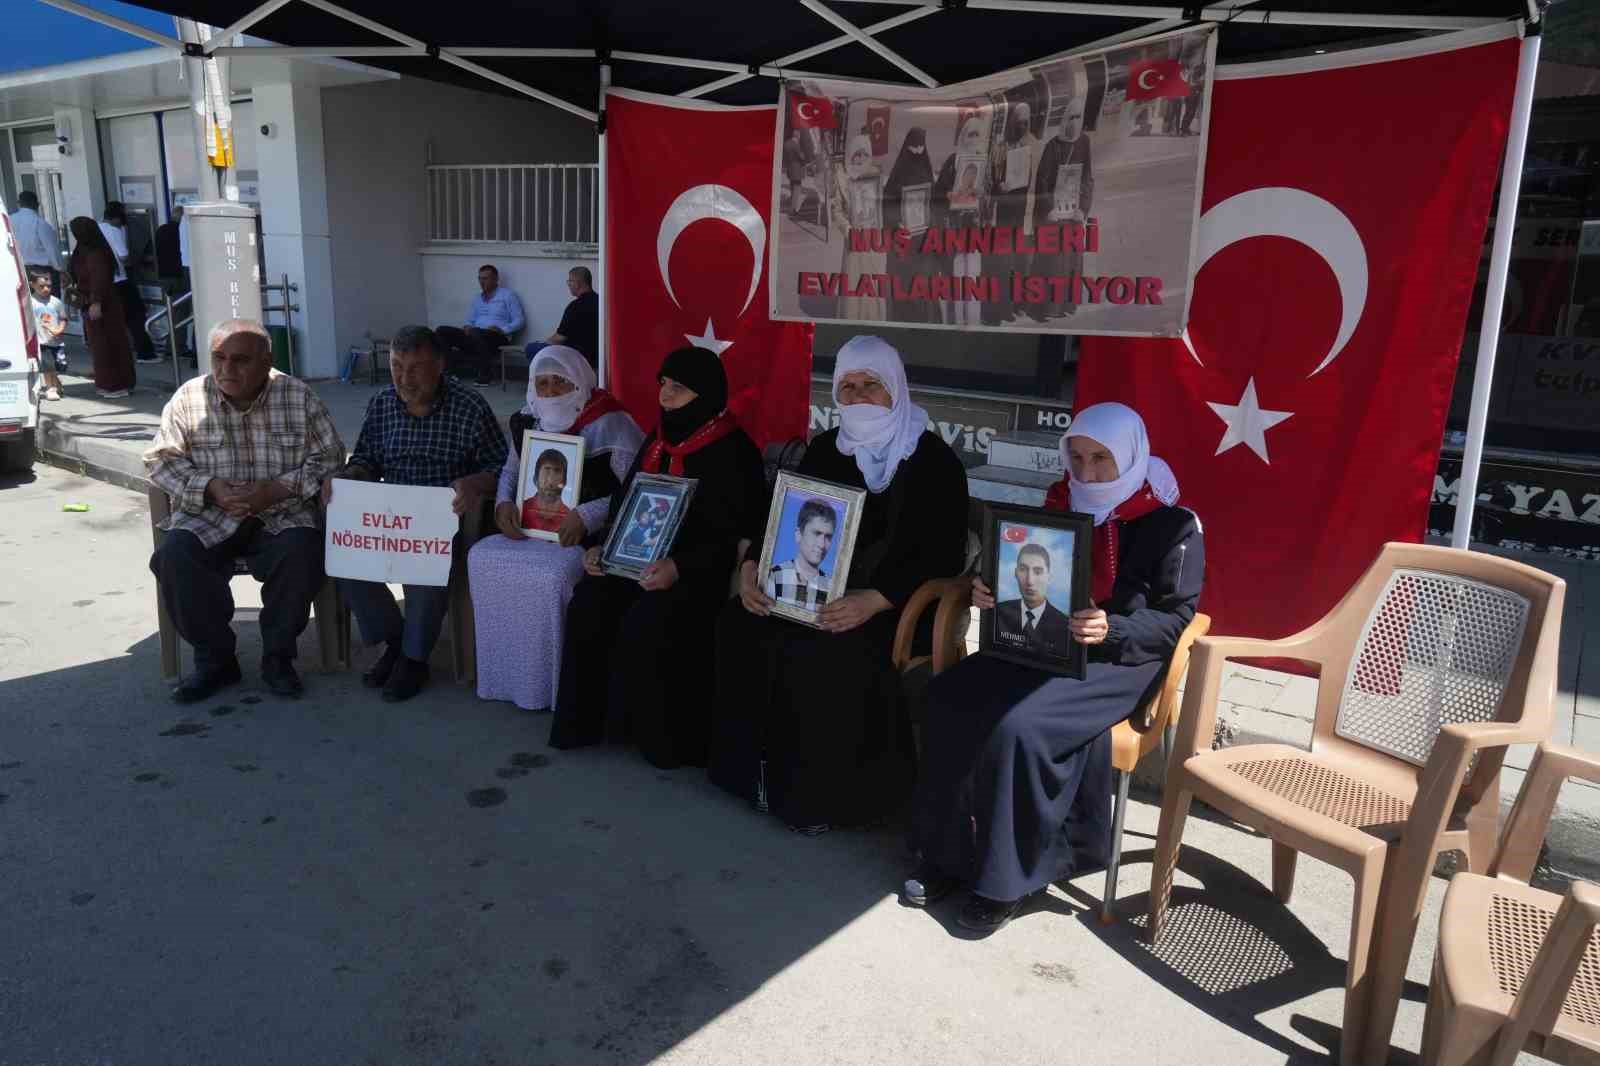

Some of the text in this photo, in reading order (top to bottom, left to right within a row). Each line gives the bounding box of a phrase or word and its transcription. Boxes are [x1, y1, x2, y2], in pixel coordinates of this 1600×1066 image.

[850, 217, 1099, 257] MUŞ ANNELERİ
[798, 270, 1164, 305] EVLATLARINI İSTİYOR
[362, 512, 413, 530] EVLAT
[332, 530, 451, 555] NÖBETİNDEYİZ
